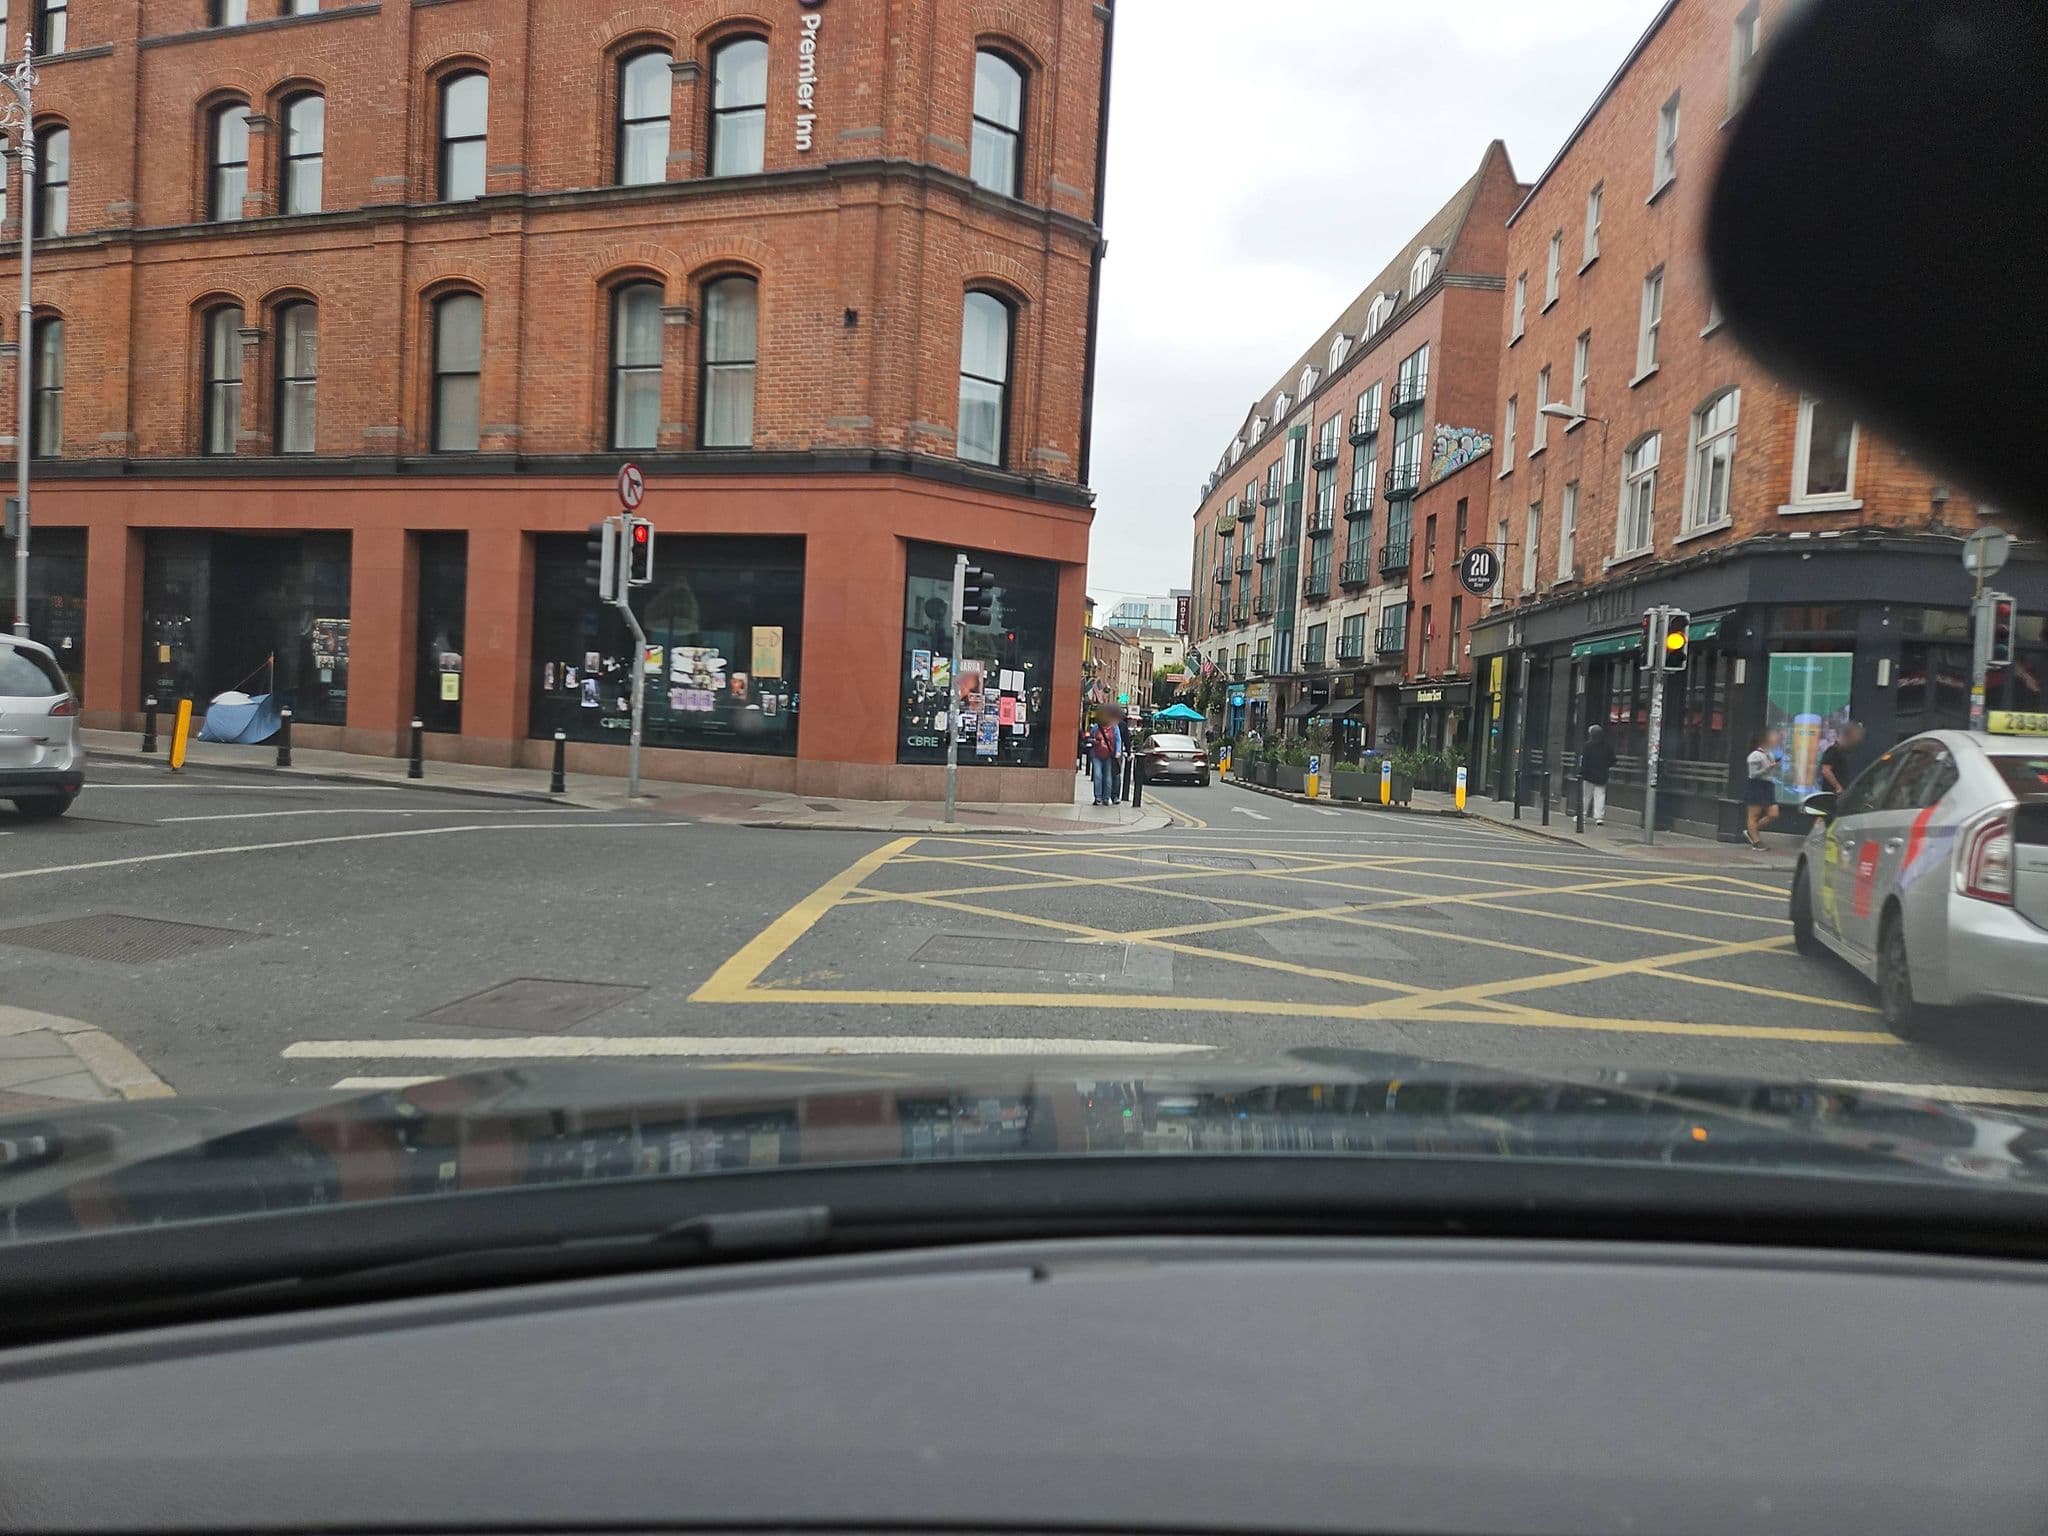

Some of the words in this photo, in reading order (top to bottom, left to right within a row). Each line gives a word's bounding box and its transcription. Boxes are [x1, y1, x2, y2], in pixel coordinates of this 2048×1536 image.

[799, 14, 821, 110] Premier
[796, 113, 817, 151] Inn
[1470, 552, 1490, 576] 20
[1179, 600, 1187, 631] HOTEL
[600, 717, 631, 728] CBRE
[907, 736, 939, 747] CBRE
